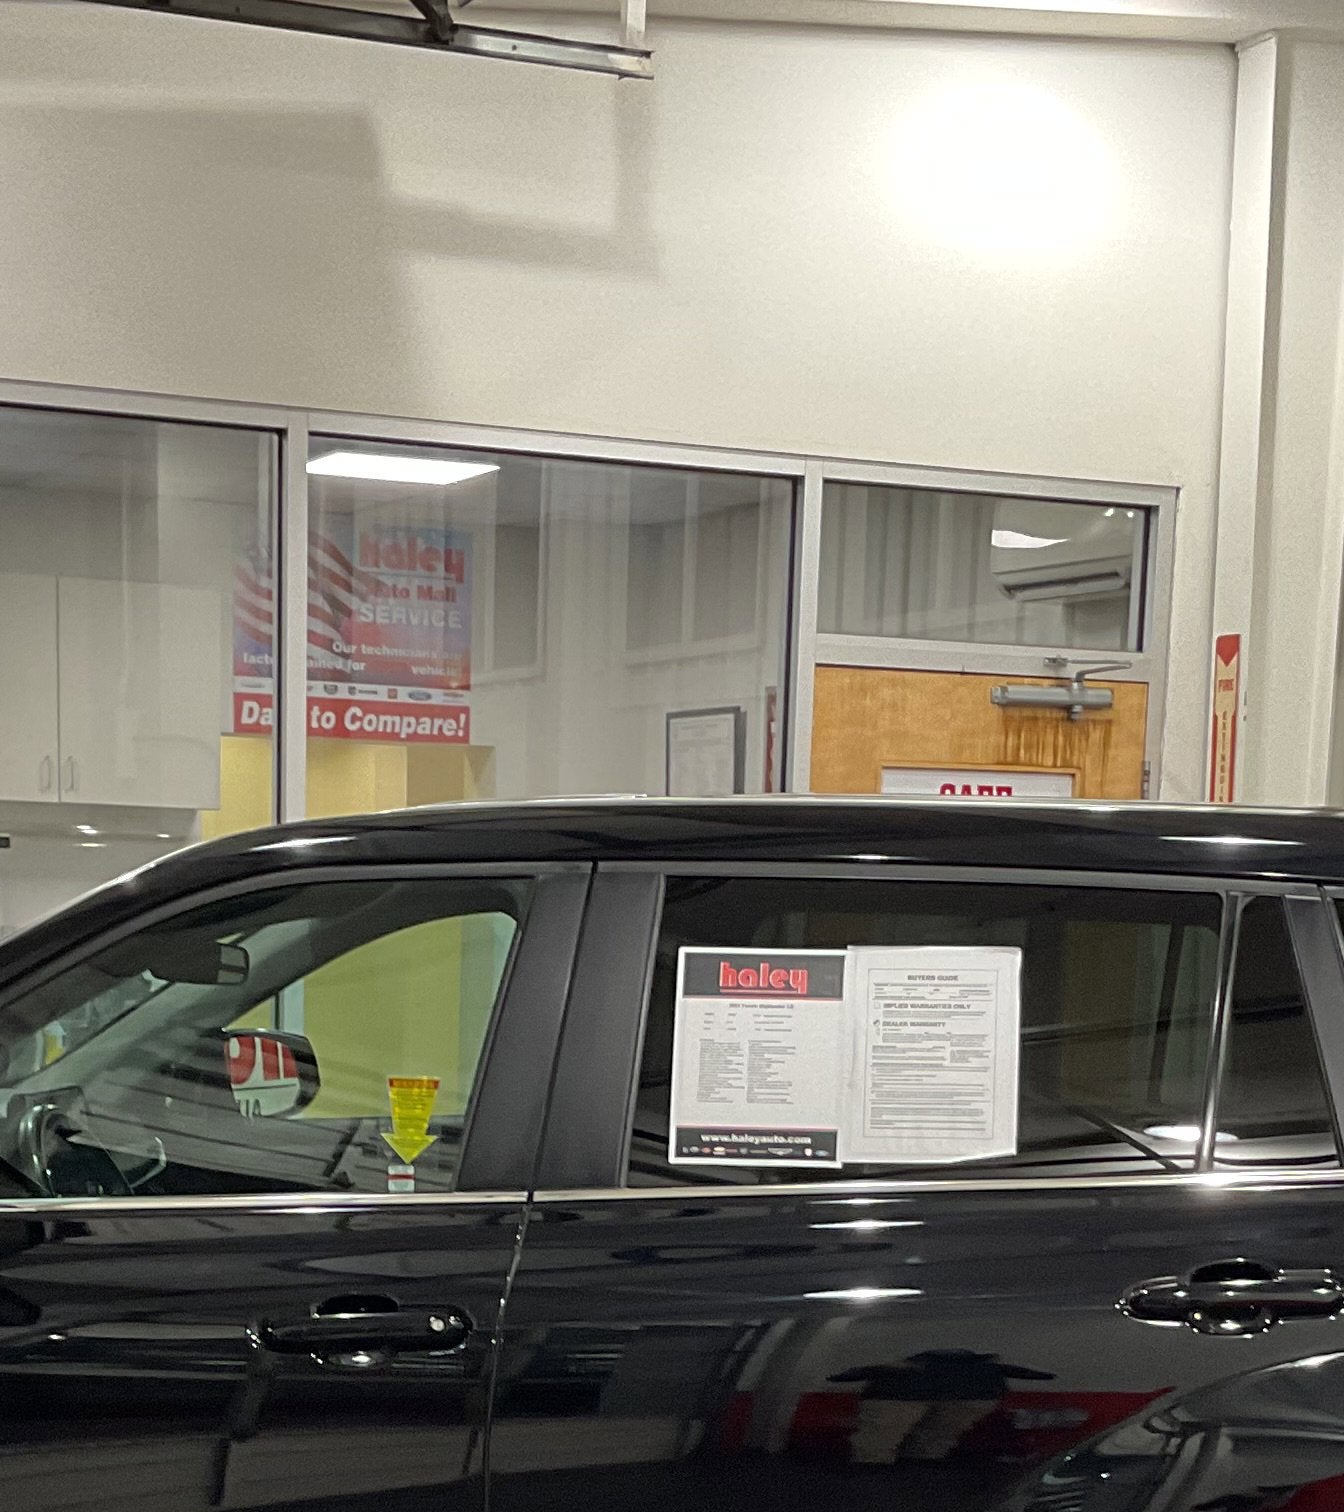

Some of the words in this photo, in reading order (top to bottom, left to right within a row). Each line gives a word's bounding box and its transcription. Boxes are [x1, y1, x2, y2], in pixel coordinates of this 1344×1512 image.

[359, 603, 463, 629] SERVICE
[332, 641, 357, 655] Our
[241, 701, 273, 726] Da
[311, 706, 336, 729] to
[344, 706, 467, 738] Compare!
[719, 961, 808, 994] haley
[700, 1133, 812, 1145] www.haleyauto.com
